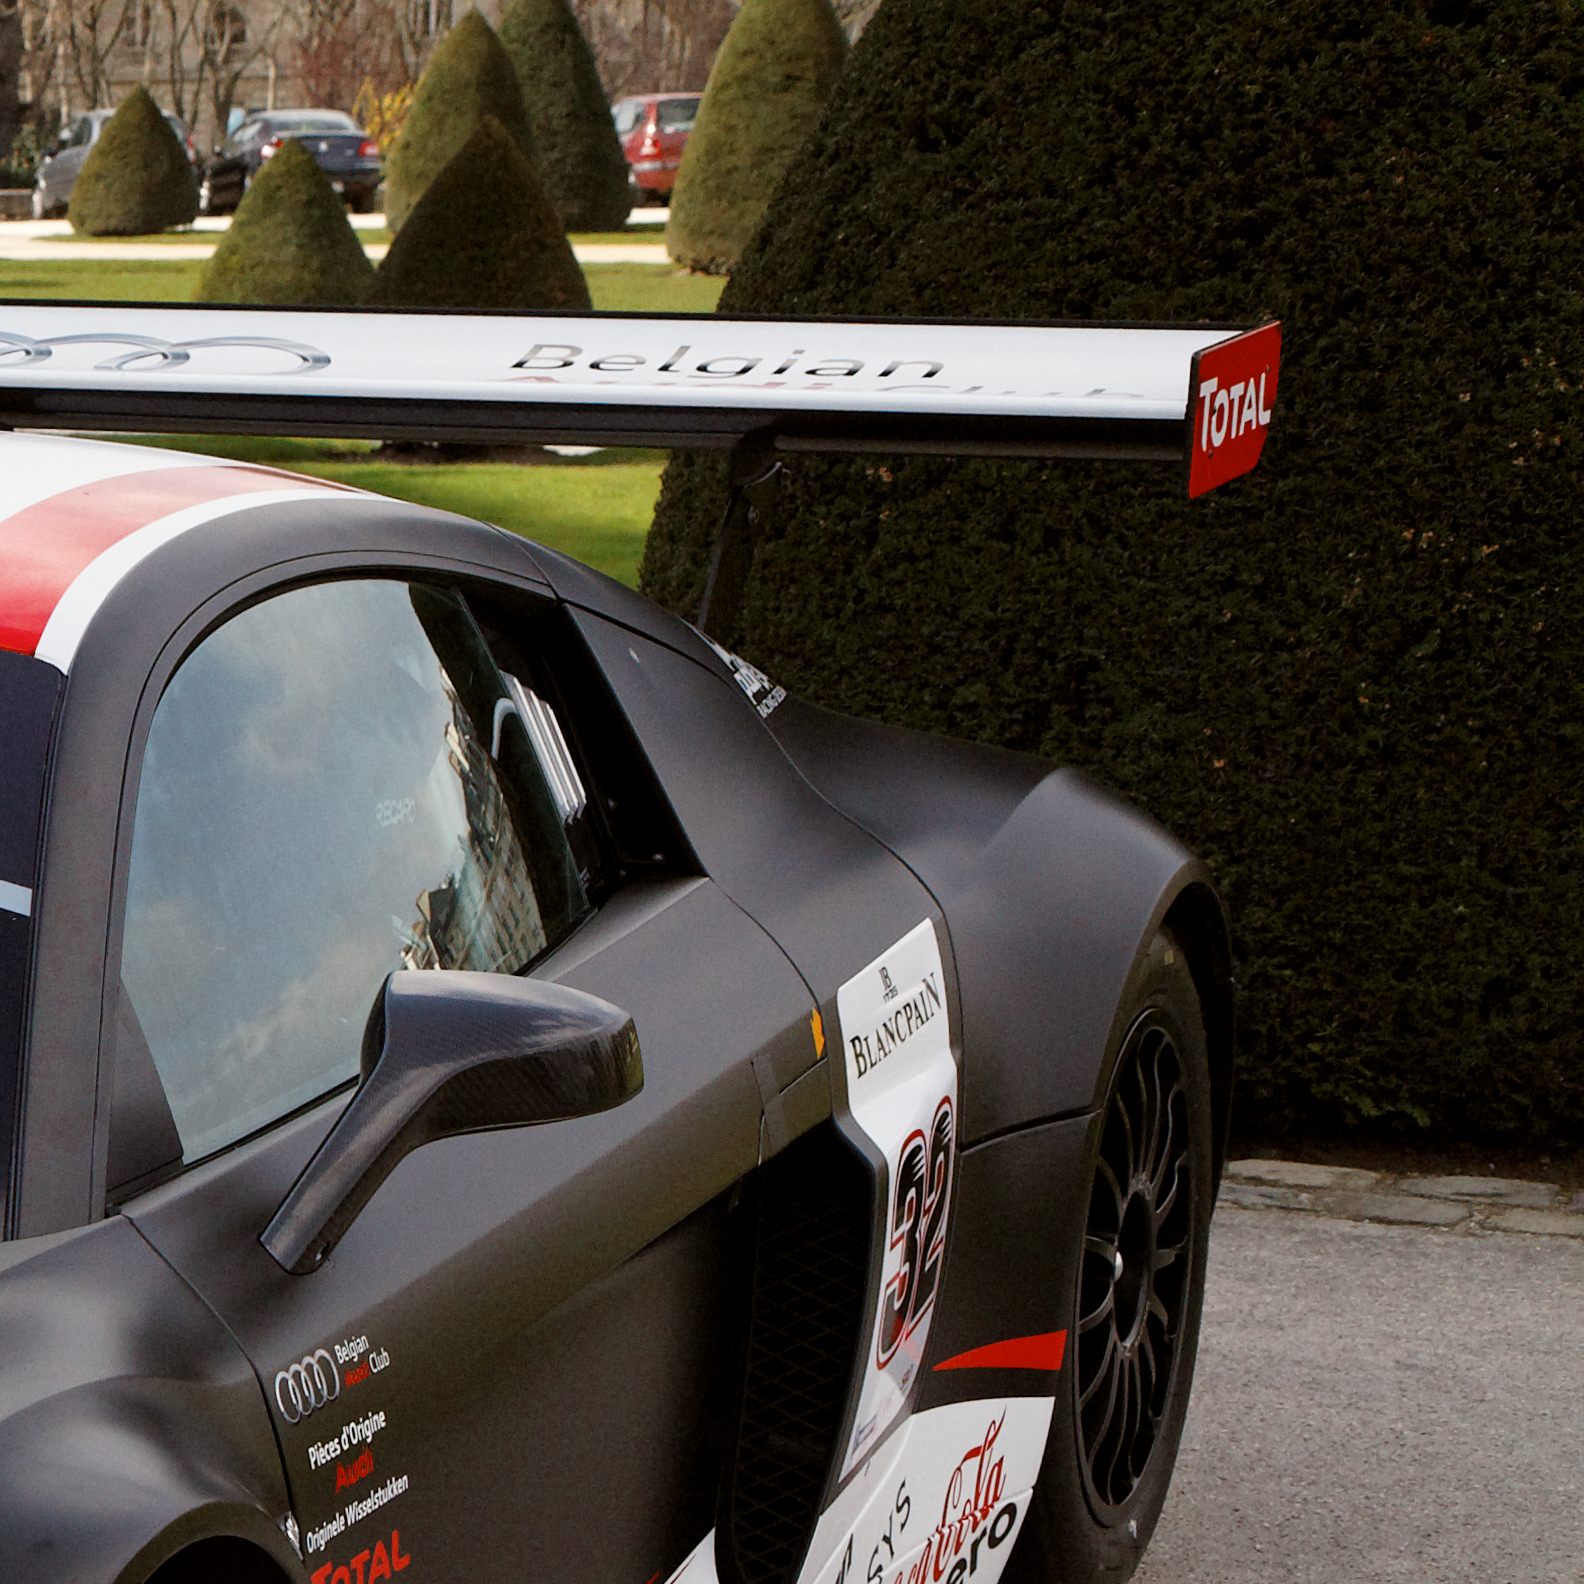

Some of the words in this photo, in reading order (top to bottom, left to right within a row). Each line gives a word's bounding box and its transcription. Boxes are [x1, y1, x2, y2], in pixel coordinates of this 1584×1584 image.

[510, 343, 946, 379] Belgian
[1199, 372, 1271, 452] TOTAL
[849, 972, 942, 1079] BLANCPAIN
[876, 1096, 953, 1371] 32
[334, 1335, 369, 1365] Belgian
[369, 1347, 391, 1374] Club
[308, 1440, 341, 1470] Pièces
[341, 1411, 386, 1451] d'Origine
[335, 1446, 374, 1493] Audi
[306, 1512, 346, 1554] Originele
[345, 1474, 409, 1527] Wisselstukken
